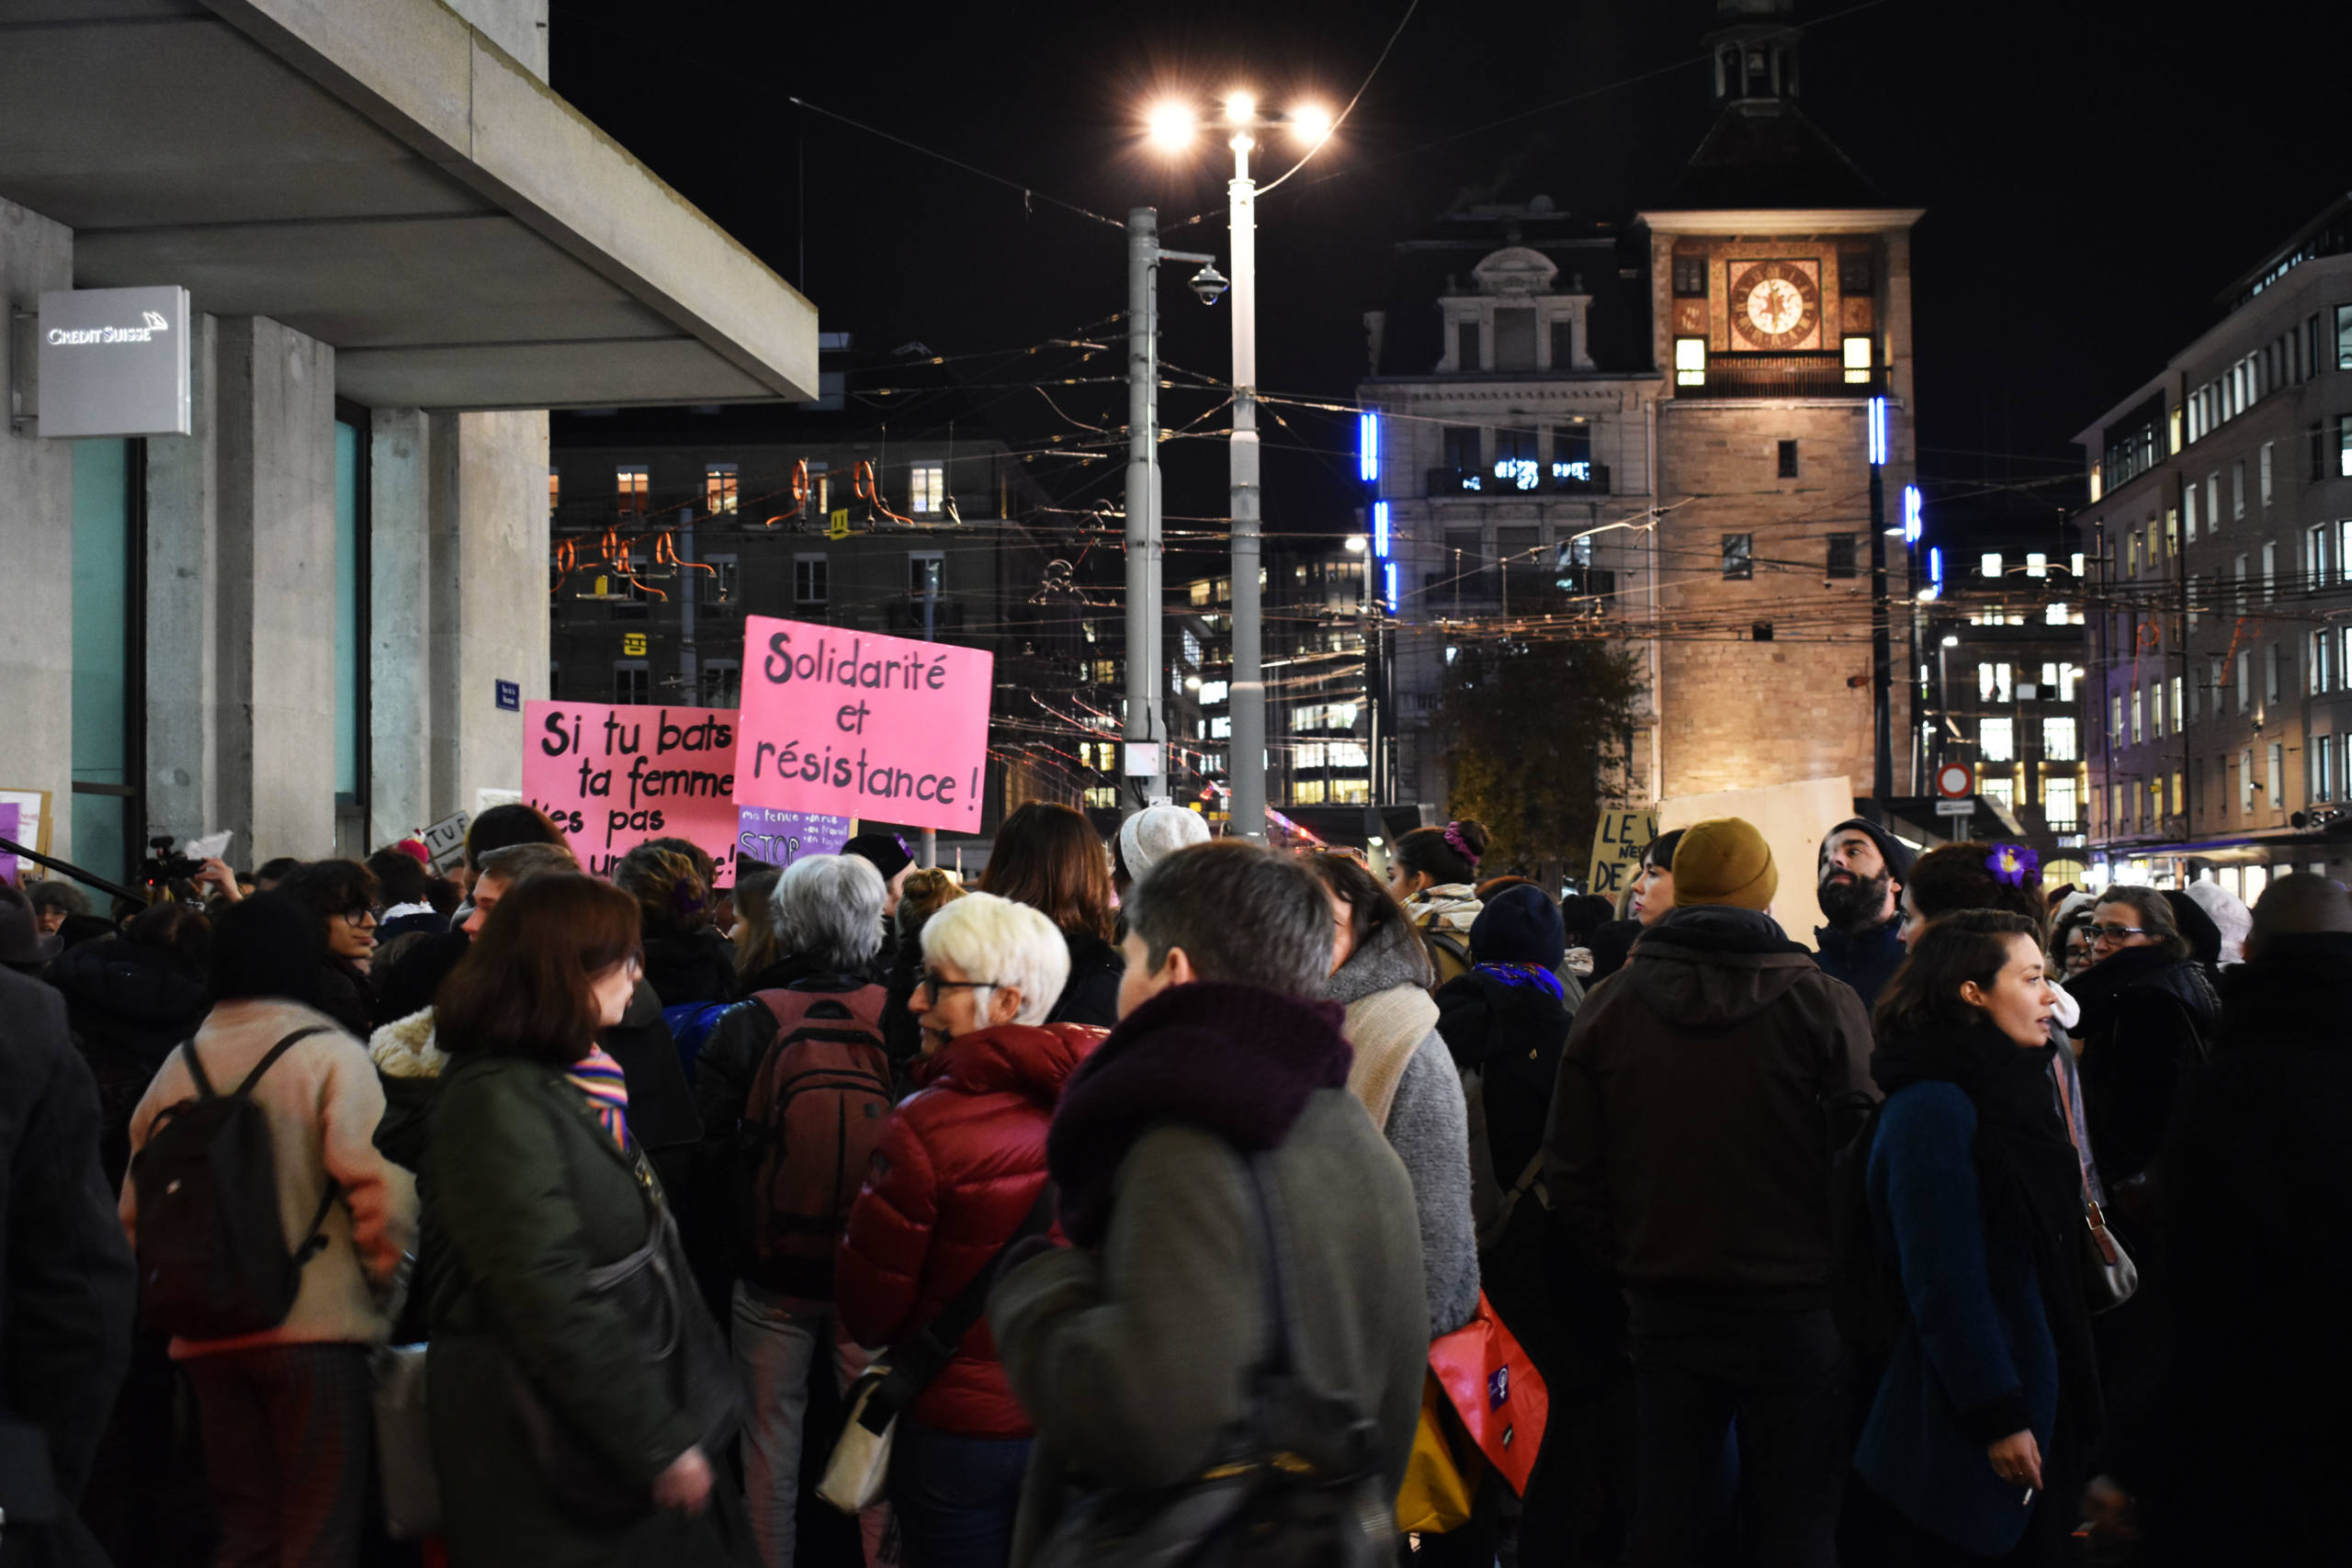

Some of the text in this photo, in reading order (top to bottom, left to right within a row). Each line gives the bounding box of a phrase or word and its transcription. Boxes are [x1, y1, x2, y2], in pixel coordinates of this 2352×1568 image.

[48, 326, 152, 344] CREDIT SUISSE
[764, 632, 947, 690] Solidarité
[542, 709, 732, 757] Si tu bats
[837, 699, 870, 735] et
[578, 755, 733, 809] ta femme
[754, 739, 956, 805] résistance
[532, 798, 664, 849] 'es pas
[764, 809, 798, 821] tenue
[1602, 814, 1637, 843] LE
[741, 830, 799, 865] STOP
